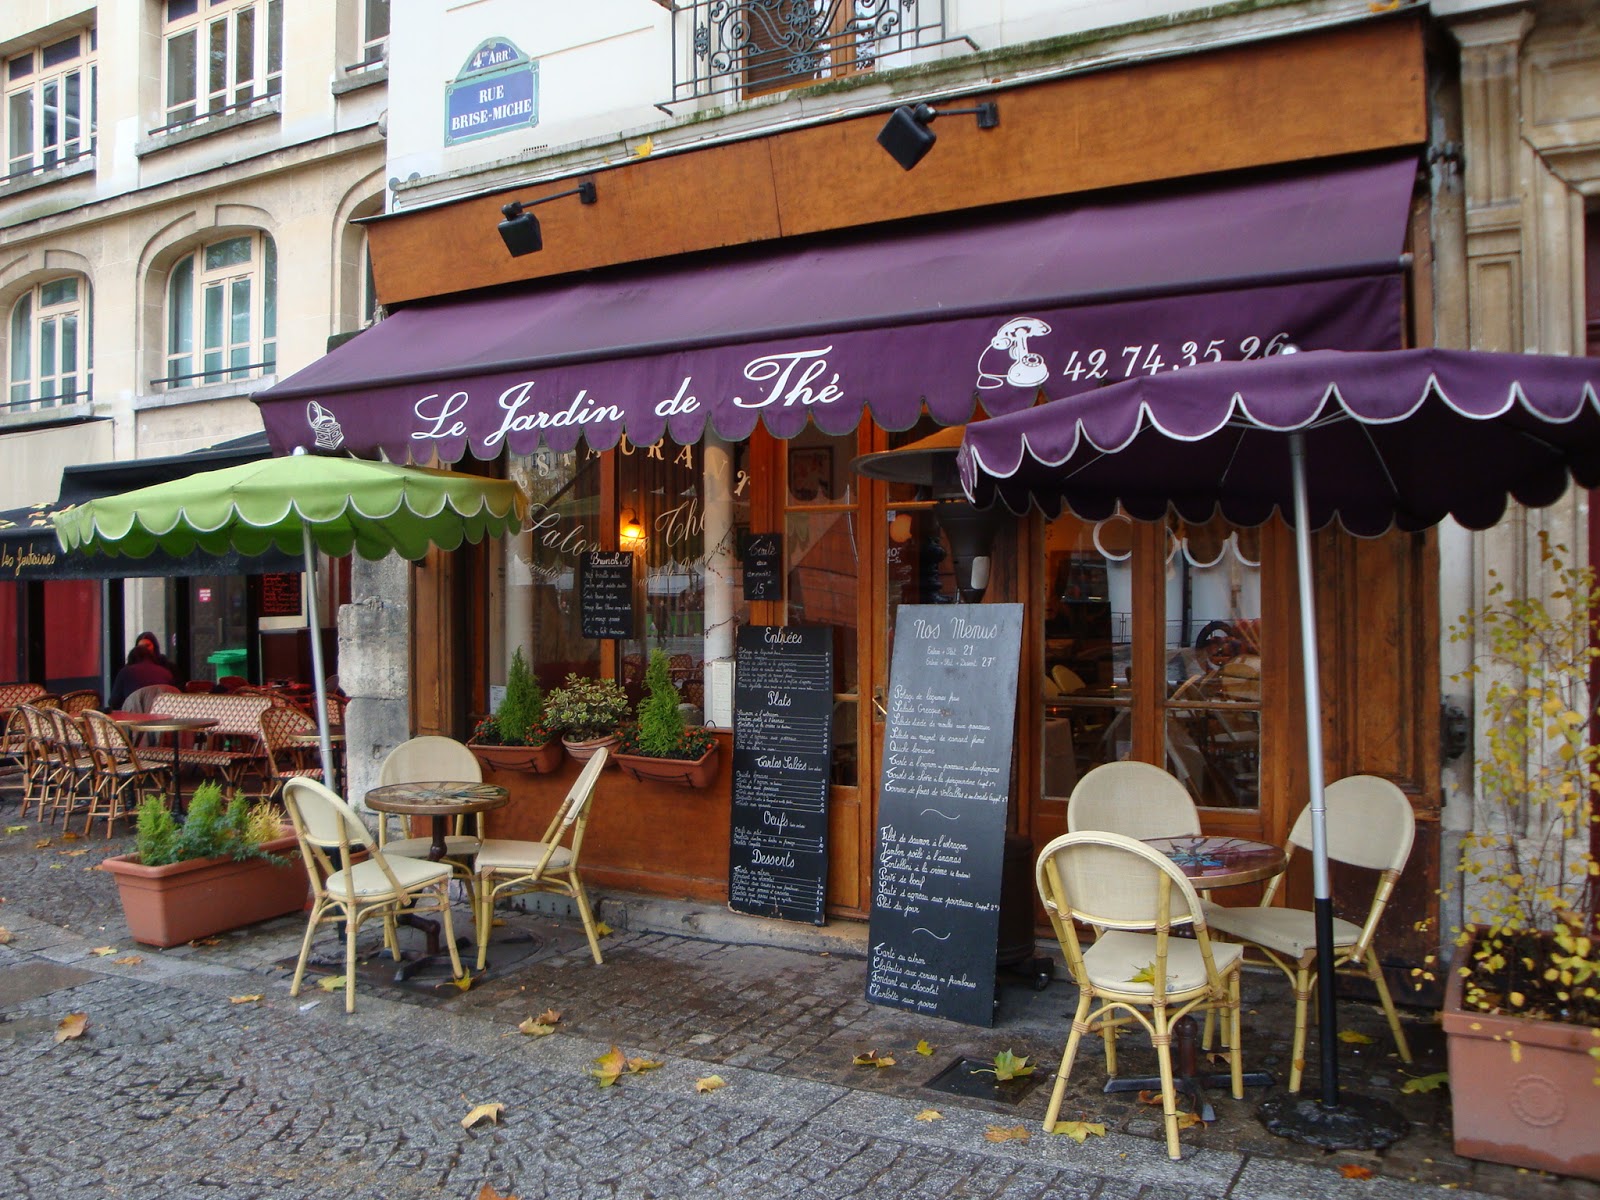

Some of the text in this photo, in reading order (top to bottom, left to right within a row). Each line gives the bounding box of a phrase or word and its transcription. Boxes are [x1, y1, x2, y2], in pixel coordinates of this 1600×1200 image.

[479, 85, 504, 104] RUE
[452, 98, 532, 130] BRISE-MICHE
[1063, 349, 1108, 381] 42
[411, 345, 844, 446] Le Jardin de Thé
[590, 552, 620, 566] Brunch
[764, 626, 803, 644] Entrées
[914, 617, 998, 639] Nos Menus
[768, 690, 792, 706] Plats
[755, 756, 782, 769] Tartes
[764, 810, 789, 835] Oeufs
[880, 824, 896, 842] Filet
[899, 834, 906, 843] de
[752, 848, 795, 868] Desserts
[880, 842, 905, 861] Jambon
[876, 894, 892, 909] Plat
